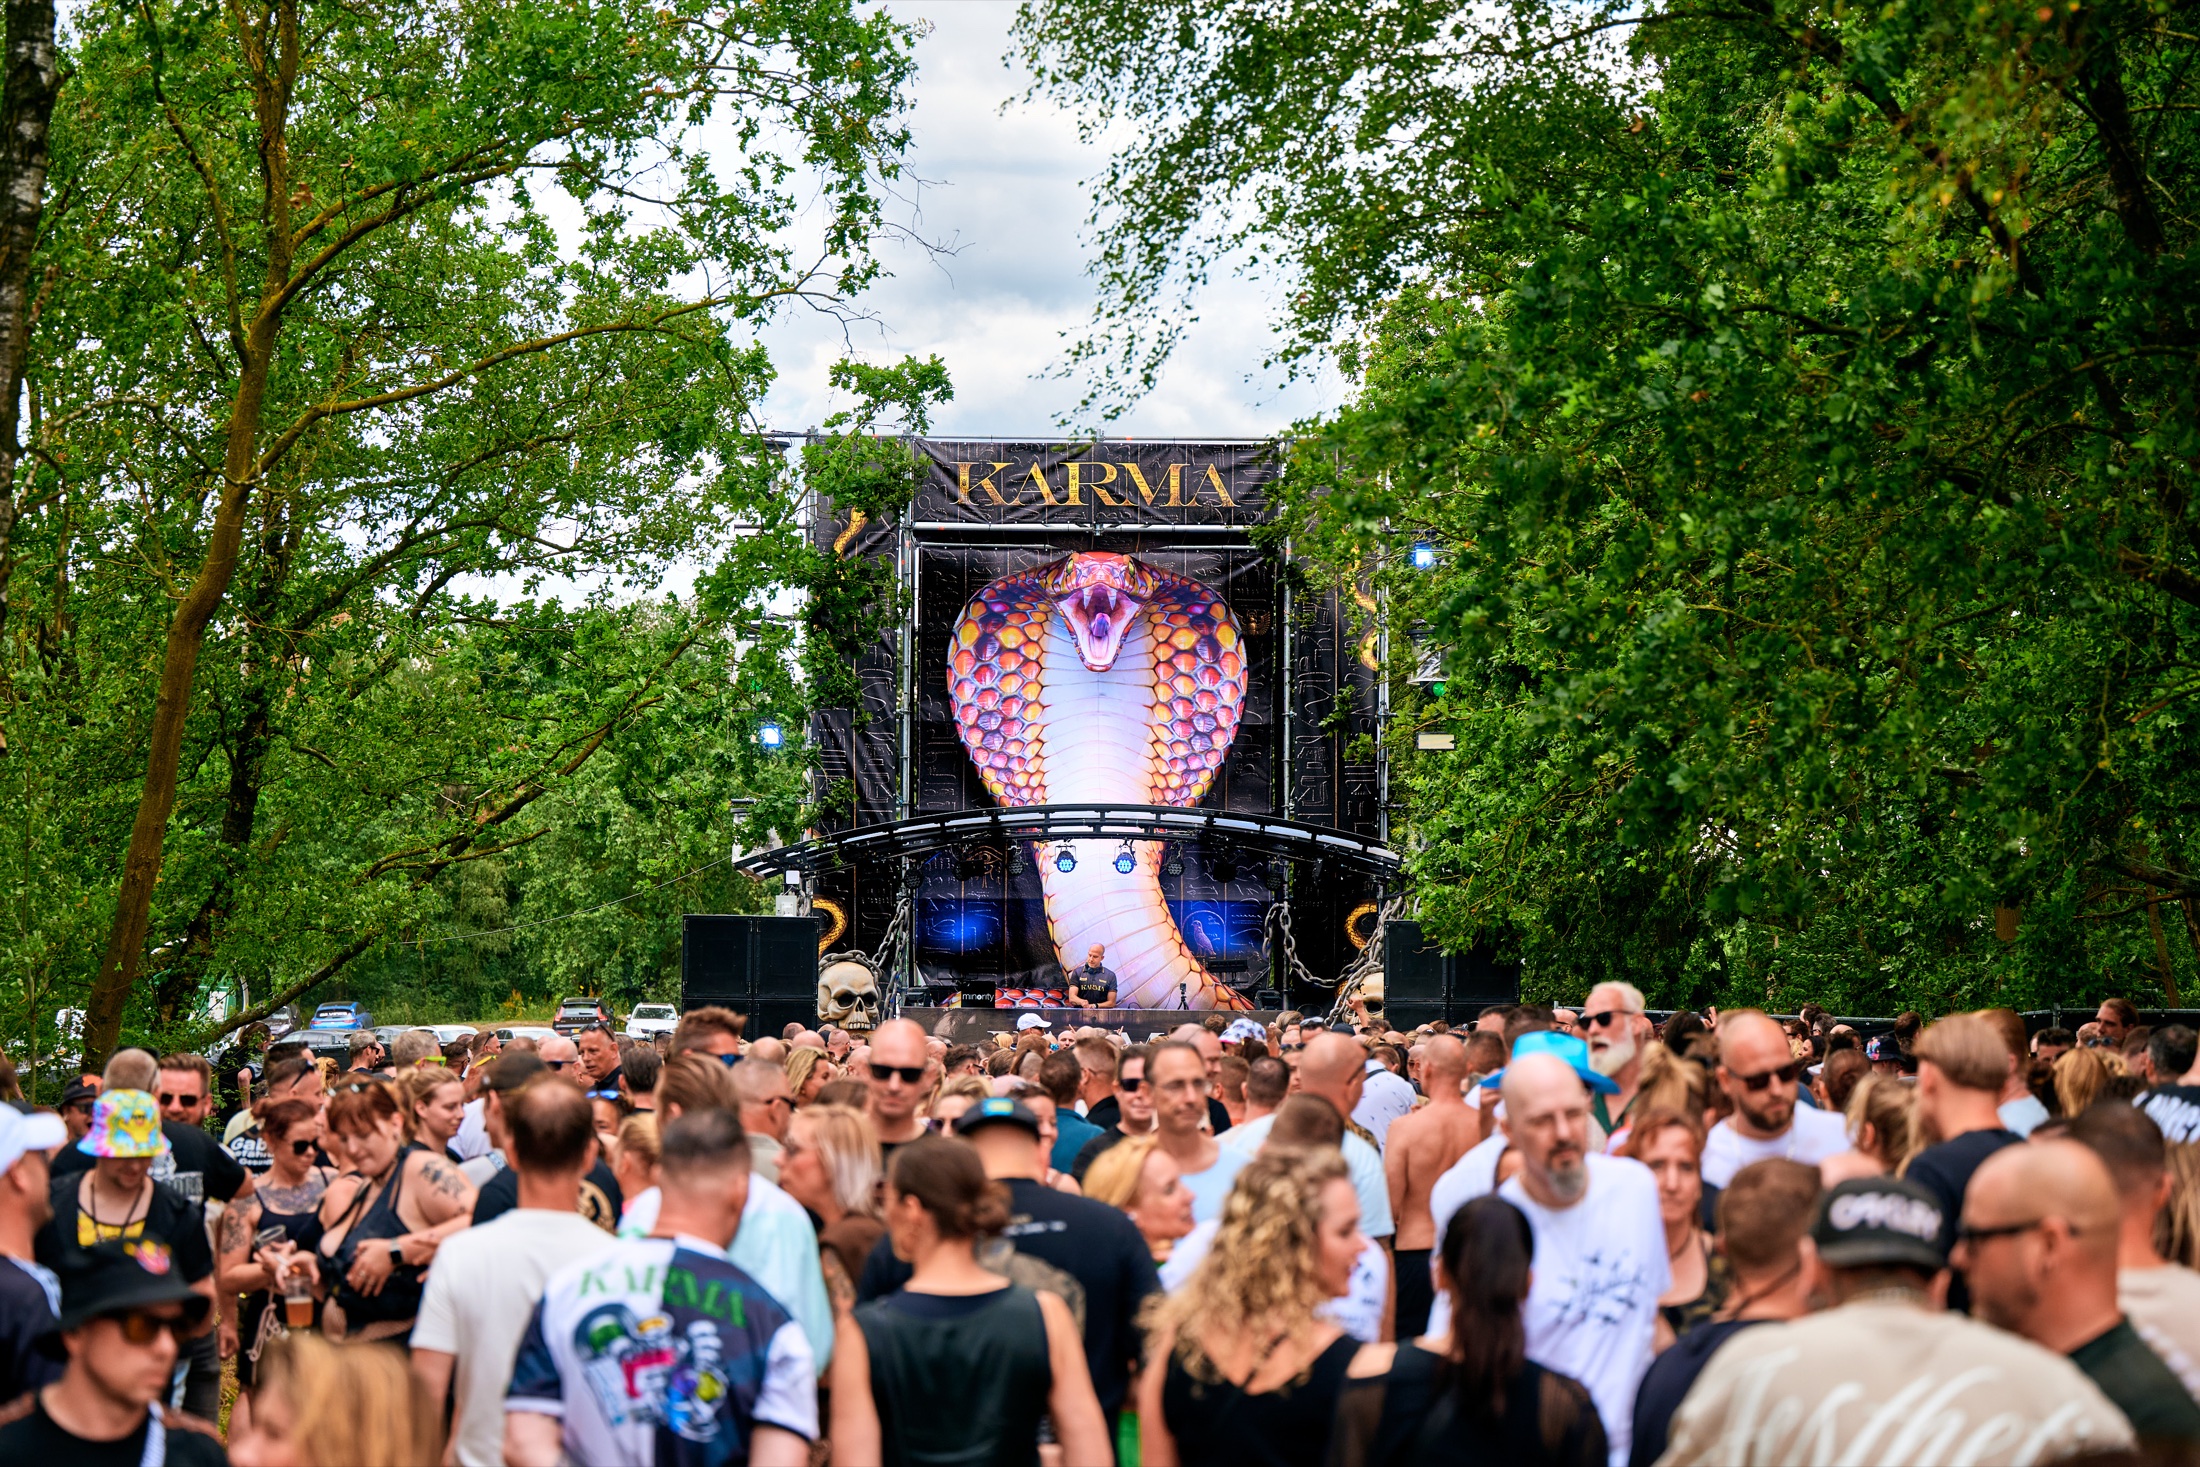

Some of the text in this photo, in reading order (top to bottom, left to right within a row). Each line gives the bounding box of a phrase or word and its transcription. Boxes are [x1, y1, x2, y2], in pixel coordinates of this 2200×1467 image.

[950, 462, 1241, 507] KARMA
[1080, 984, 1105, 992] KARMA
[962, 993, 995, 1002] minority
[230, 1136, 268, 1152] Gab
[576, 1262, 748, 1329] KARMA
